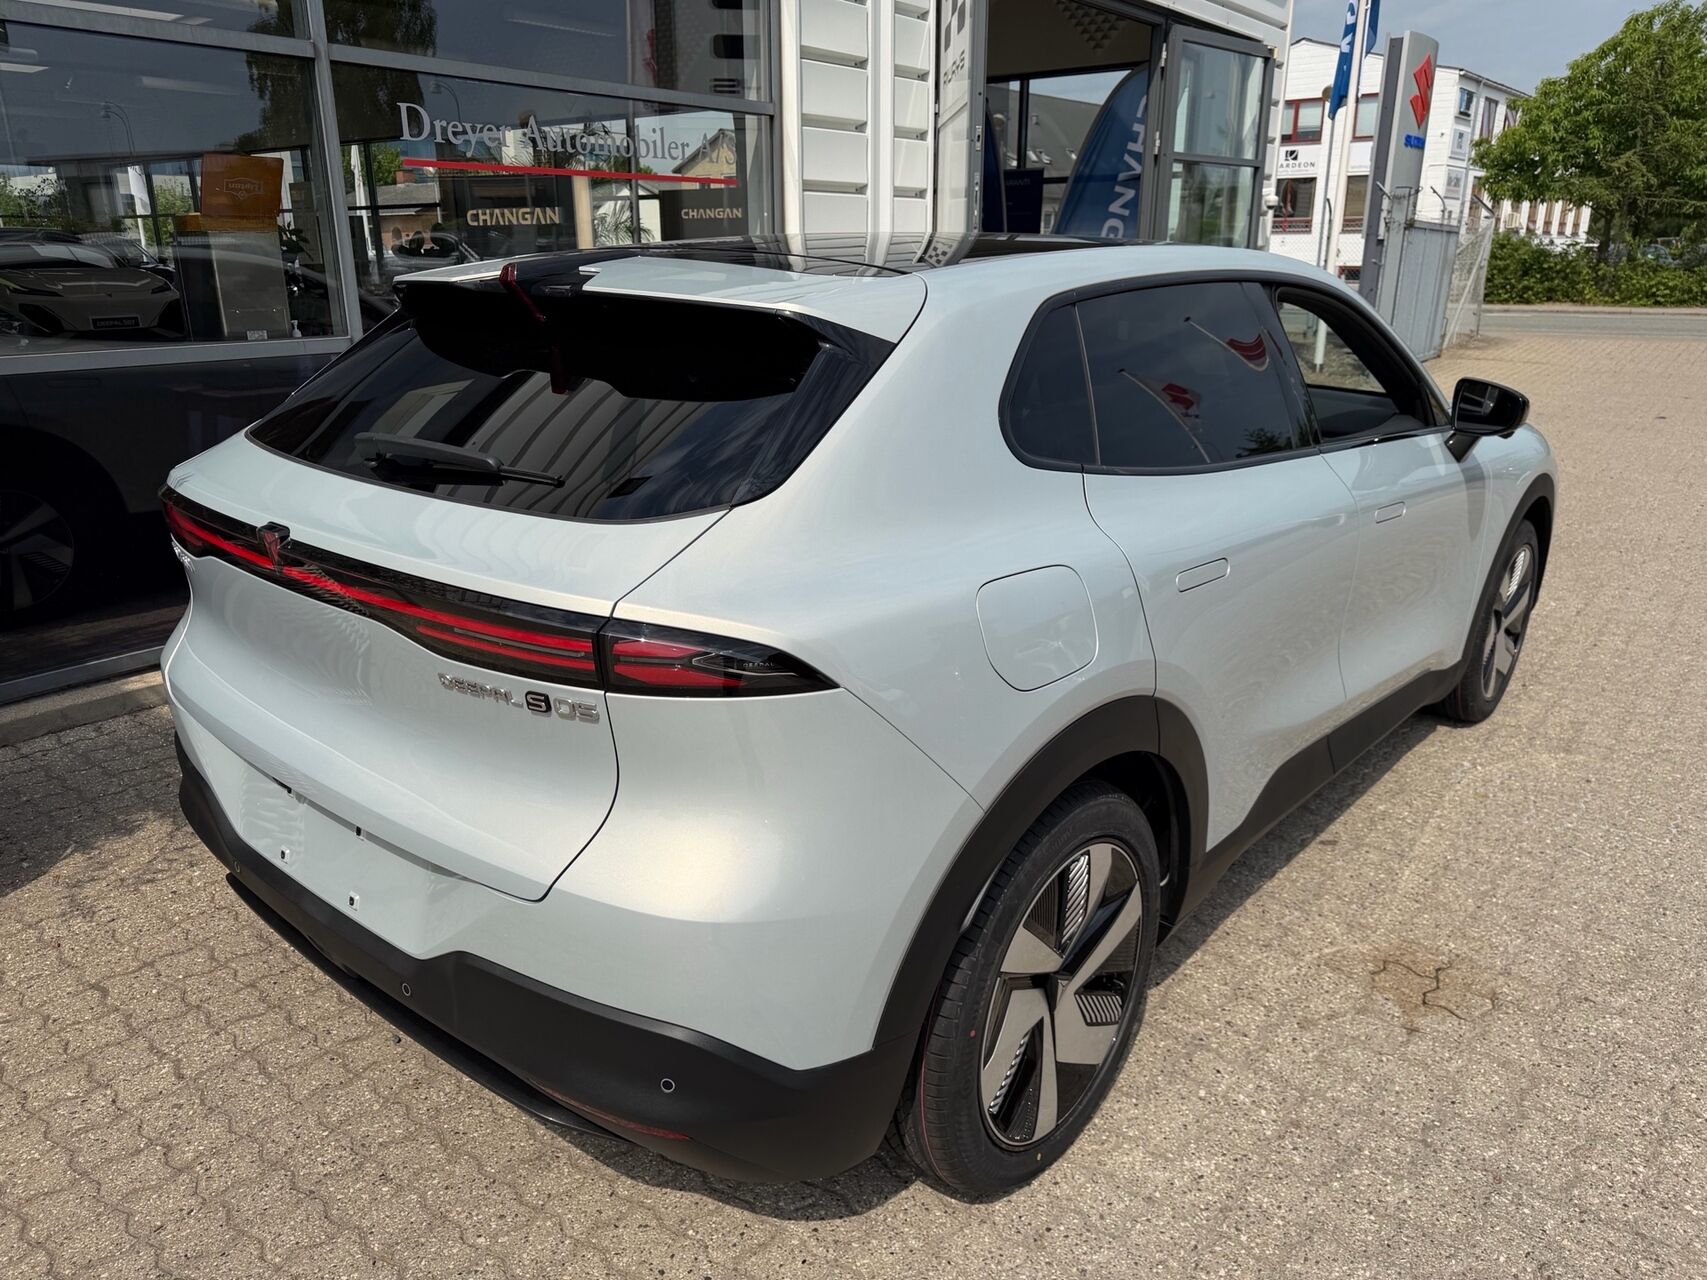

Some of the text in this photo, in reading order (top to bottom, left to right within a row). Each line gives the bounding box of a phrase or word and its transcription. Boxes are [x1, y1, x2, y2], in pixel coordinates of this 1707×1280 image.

[397, 102, 737, 165] Dreyer Automobiler A/S
[466, 207, 561, 226] CHANGAN
[681, 208, 742, 219] CHANGAN
[438, 672, 524, 709] DEEPAL
